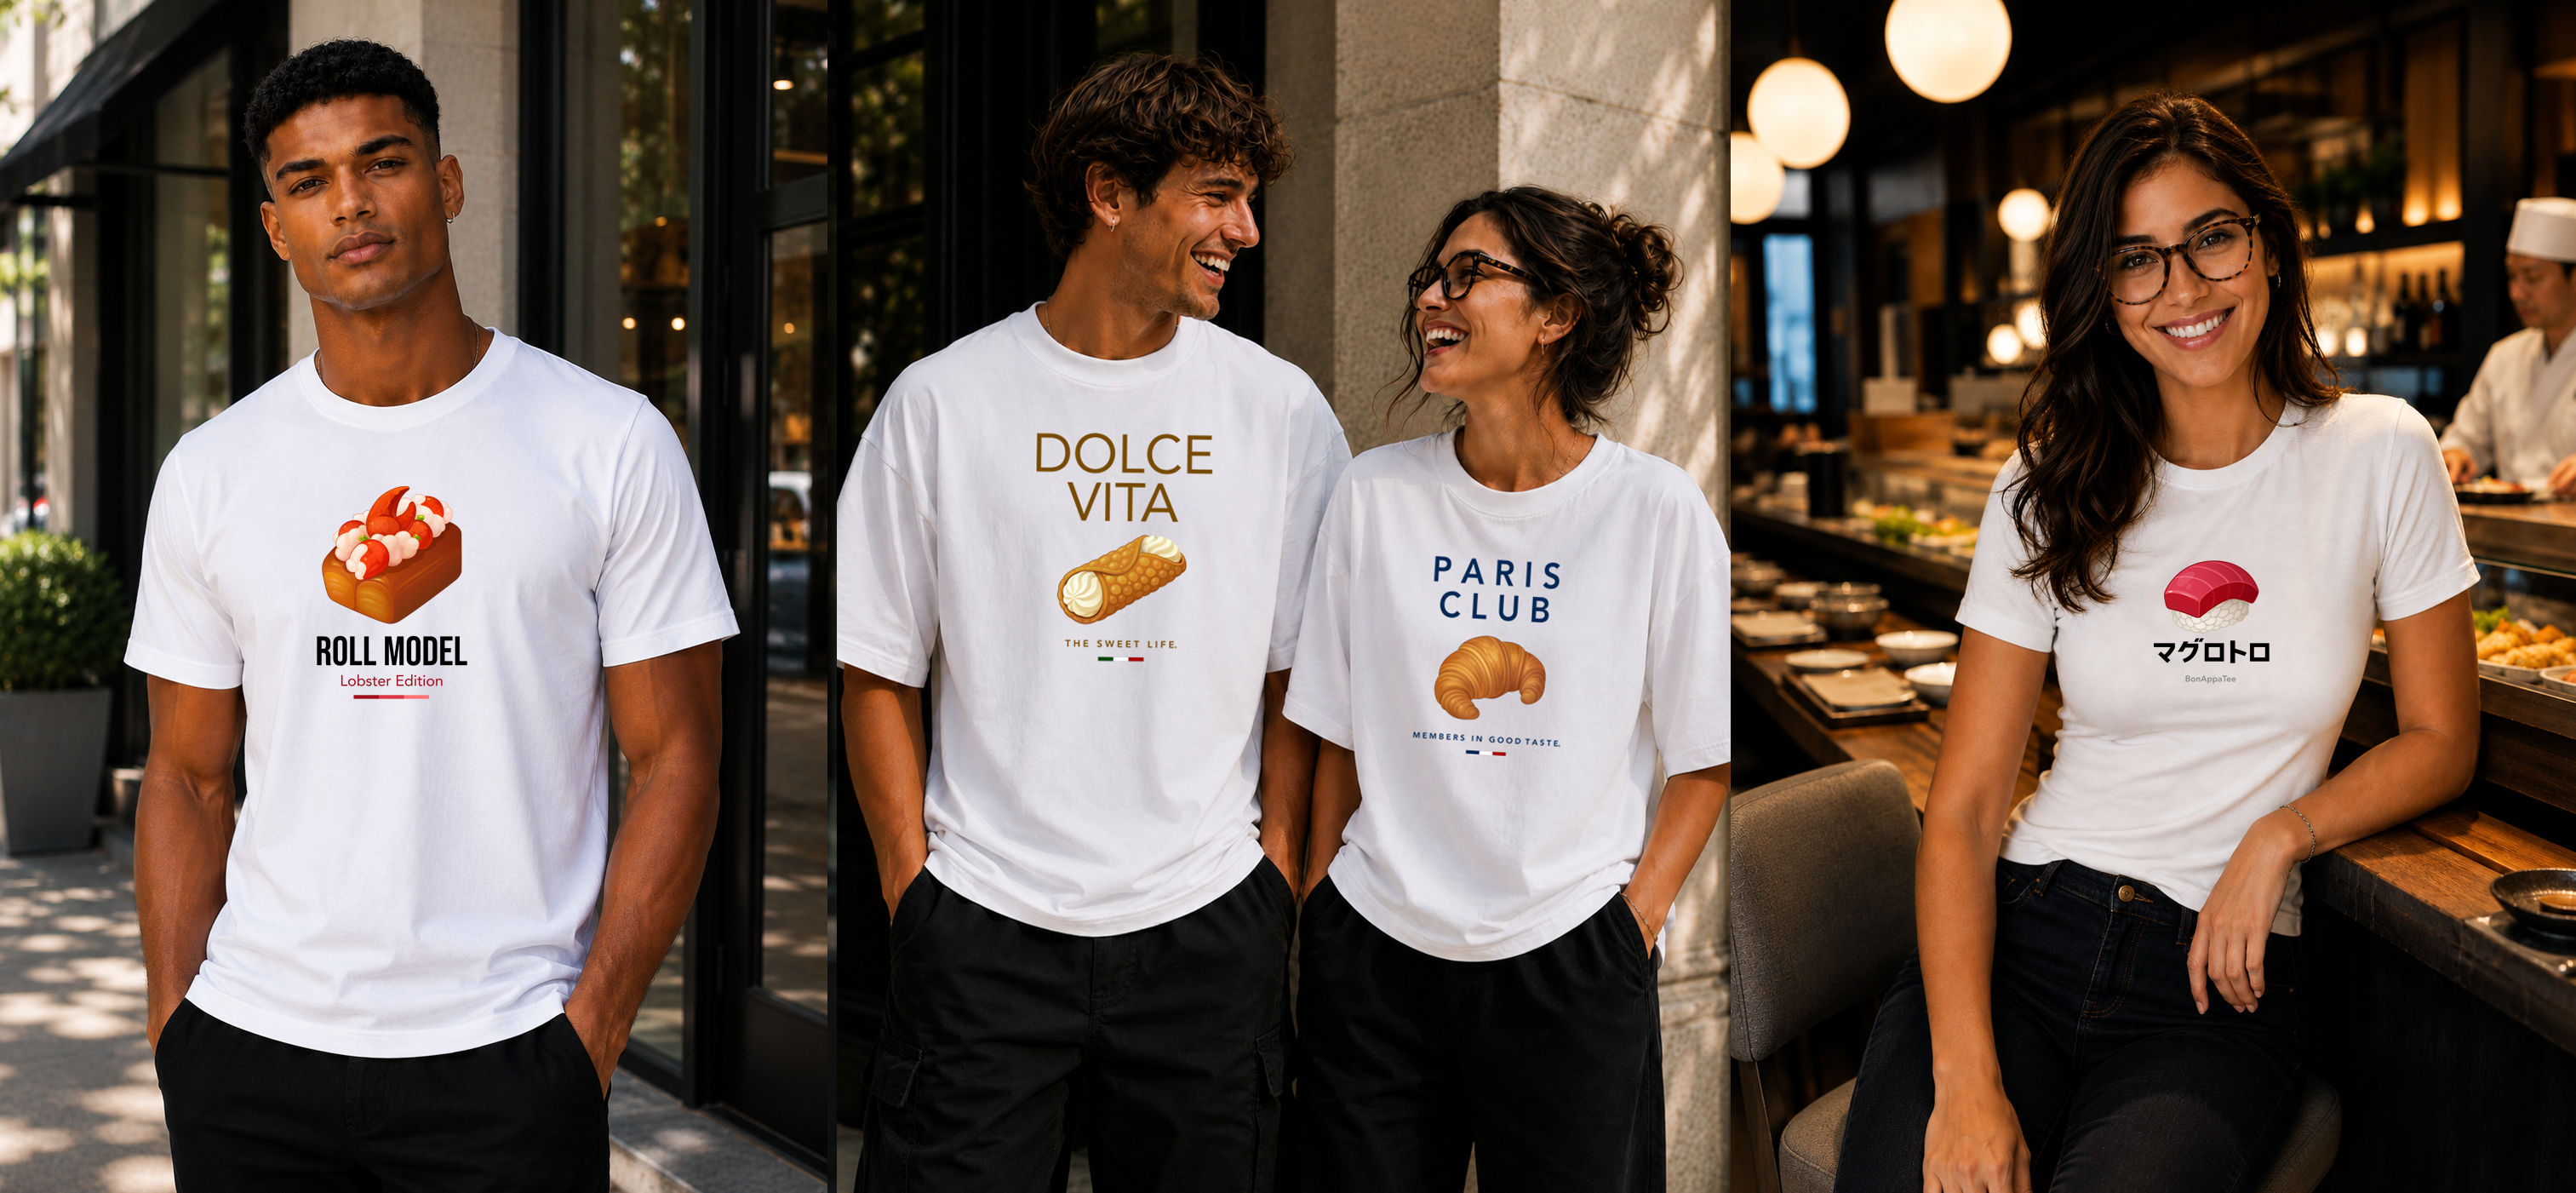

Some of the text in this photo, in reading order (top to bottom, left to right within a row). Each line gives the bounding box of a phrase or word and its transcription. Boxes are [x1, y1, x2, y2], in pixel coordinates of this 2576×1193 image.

[1036, 433, 1213, 474] DOLCE
[1067, 481, 1178, 522] VITA
[1434, 555, 1560, 590] PARIS
[1440, 590, 1550, 623] CLUB
[316, 635, 467, 666] ROLL MODEL
[1065, 639, 1177, 649] THE SWEET LIFE.
[2153, 637, 2270, 664] マグロトロ
[341, 674, 444, 687] Lobster Edition
[2184, 674, 2236, 685] BonAppaTee
[1412, 731, 1466, 742] MEMBERS
[1488, 736, 1521, 745] GOOD
[1526, 738, 1561, 748] TASTE.
